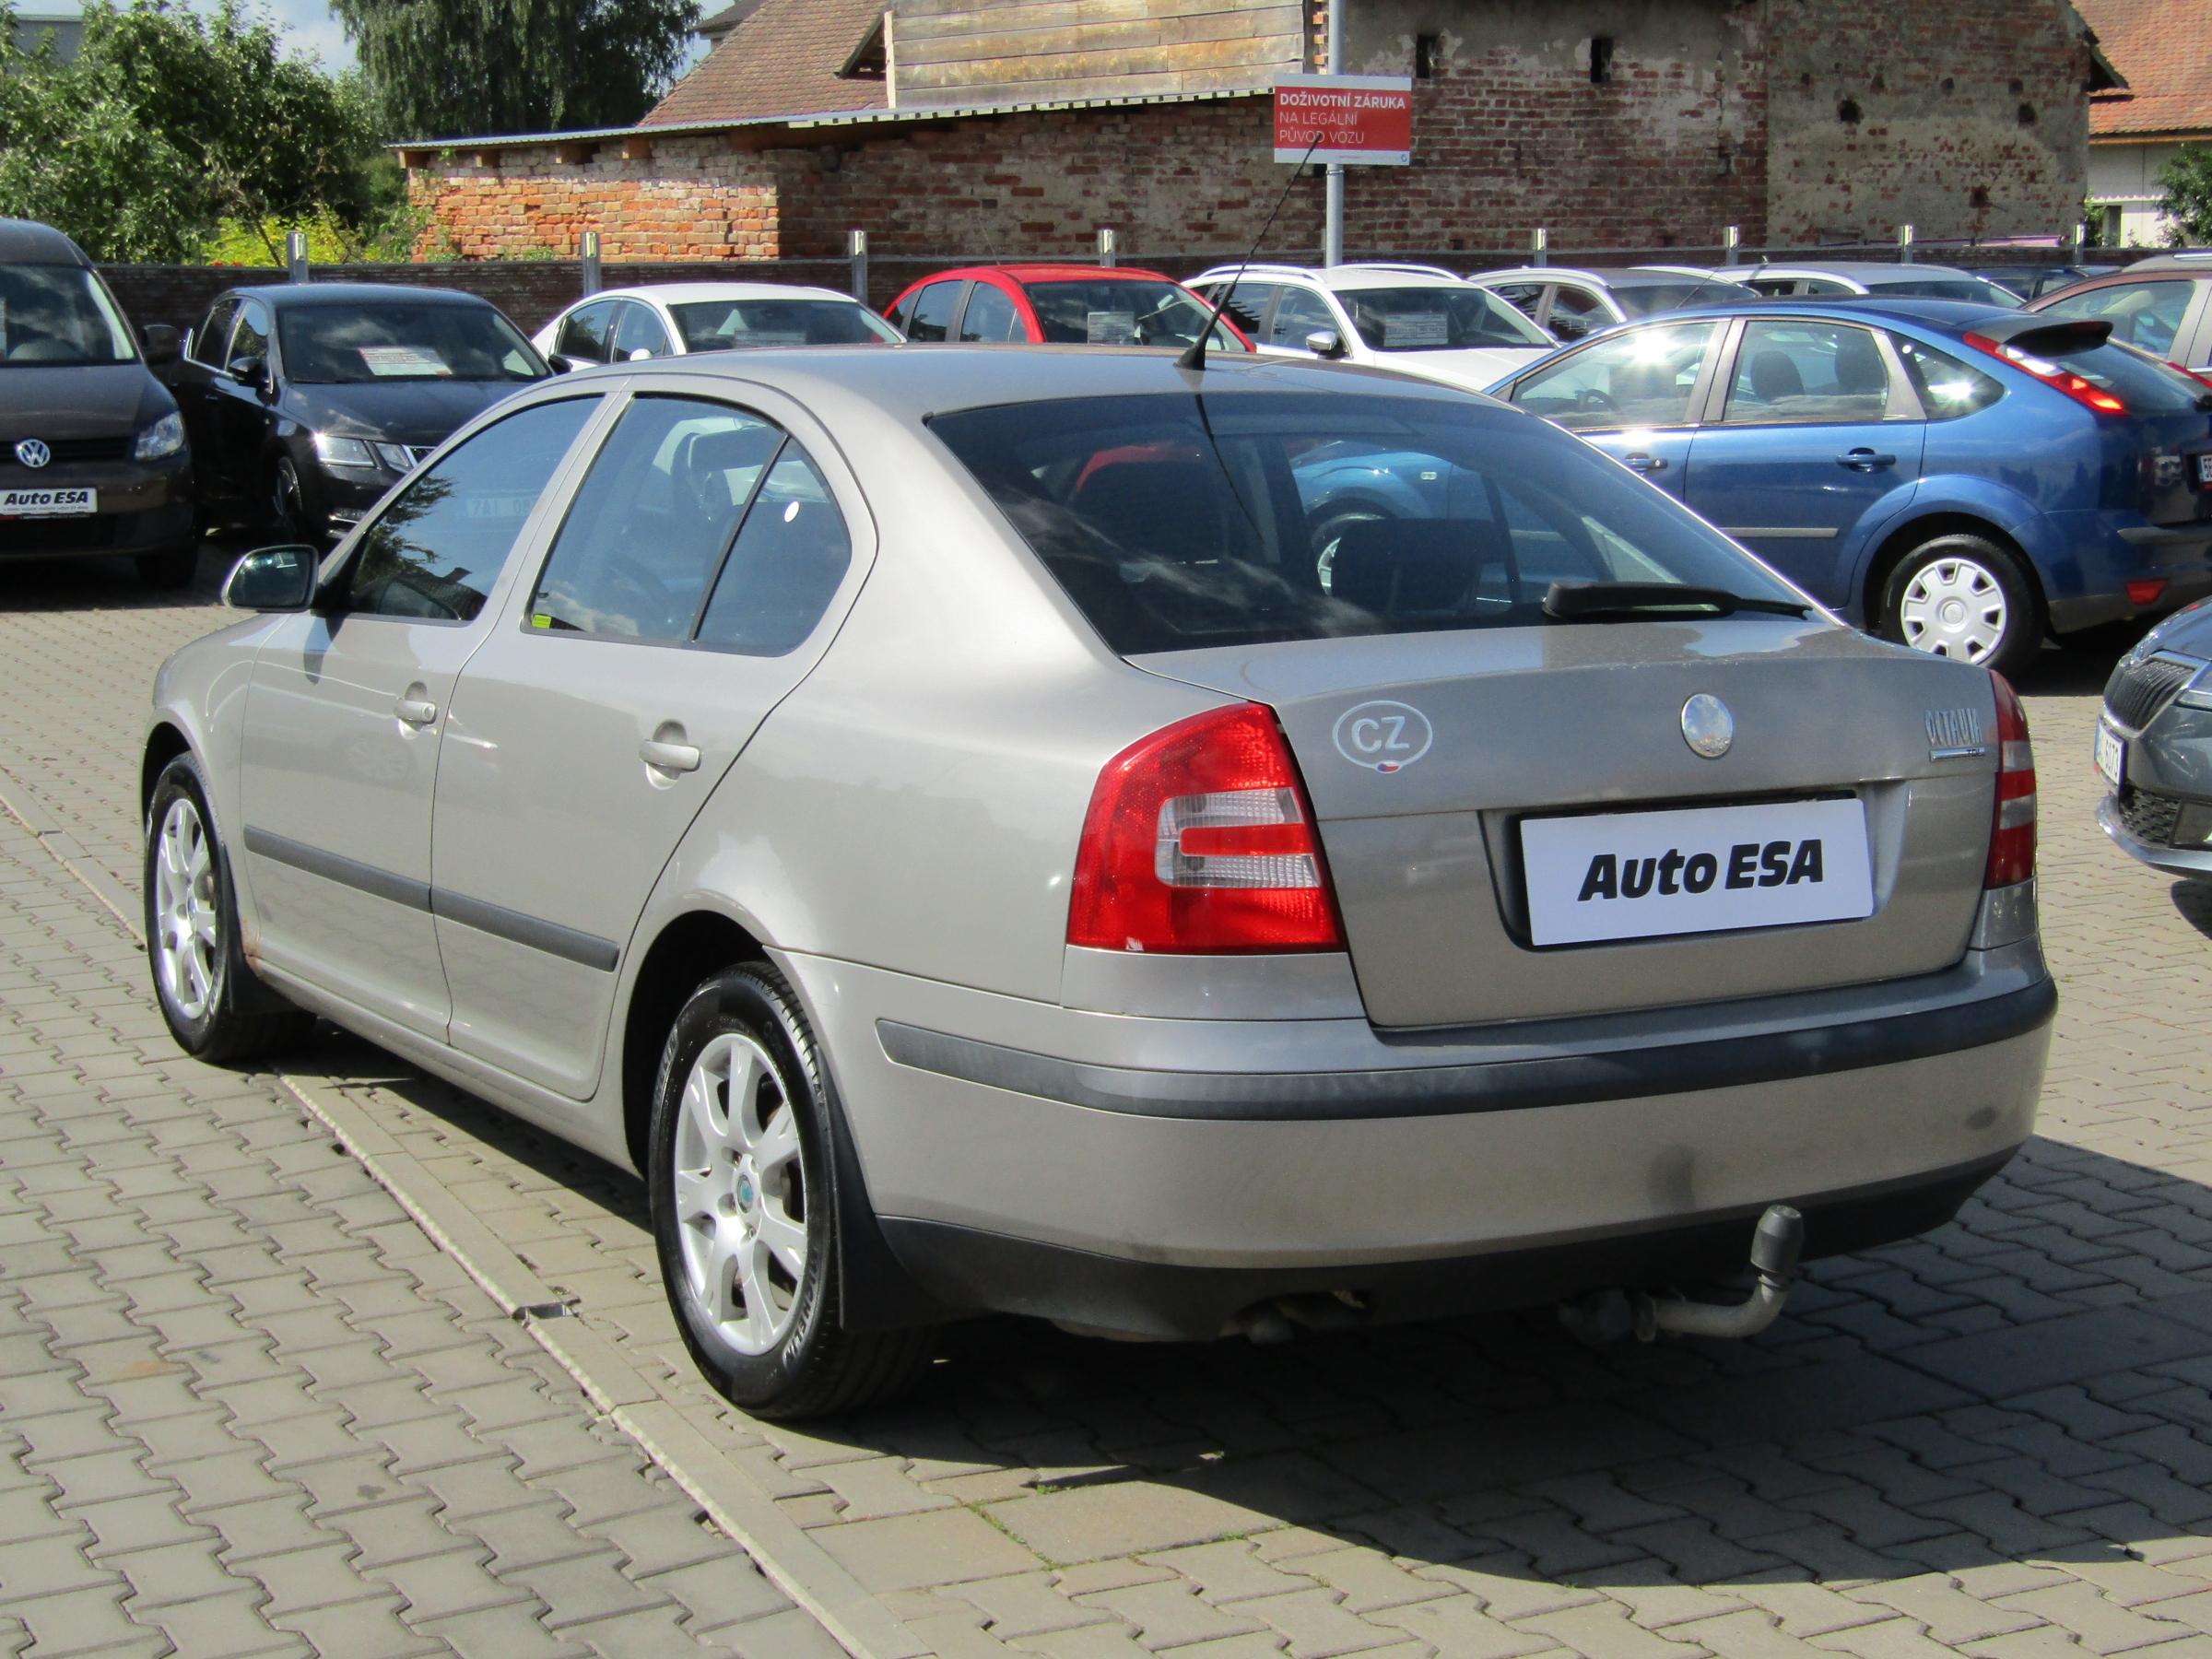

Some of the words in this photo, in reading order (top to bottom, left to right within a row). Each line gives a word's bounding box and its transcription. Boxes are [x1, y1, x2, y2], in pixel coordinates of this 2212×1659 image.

[1280, 91, 1350, 108] DOŽIVOTNÍ
[1354, 93, 1406, 110] ZÁRUKA
[1280, 112, 1299, 124] NA
[1302, 110, 1358, 125] LEGÁLNÍ
[1280, 126, 1325, 144] PŮVOD
[1329, 131, 1365, 144] VOZU
[4, 493, 52, 505] Auto
[53, 491, 88, 504] ESA
[1351, 715, 1410, 753] CZ
[1577, 848, 1718, 902] Auto
[1725, 839, 1824, 890] ESA
